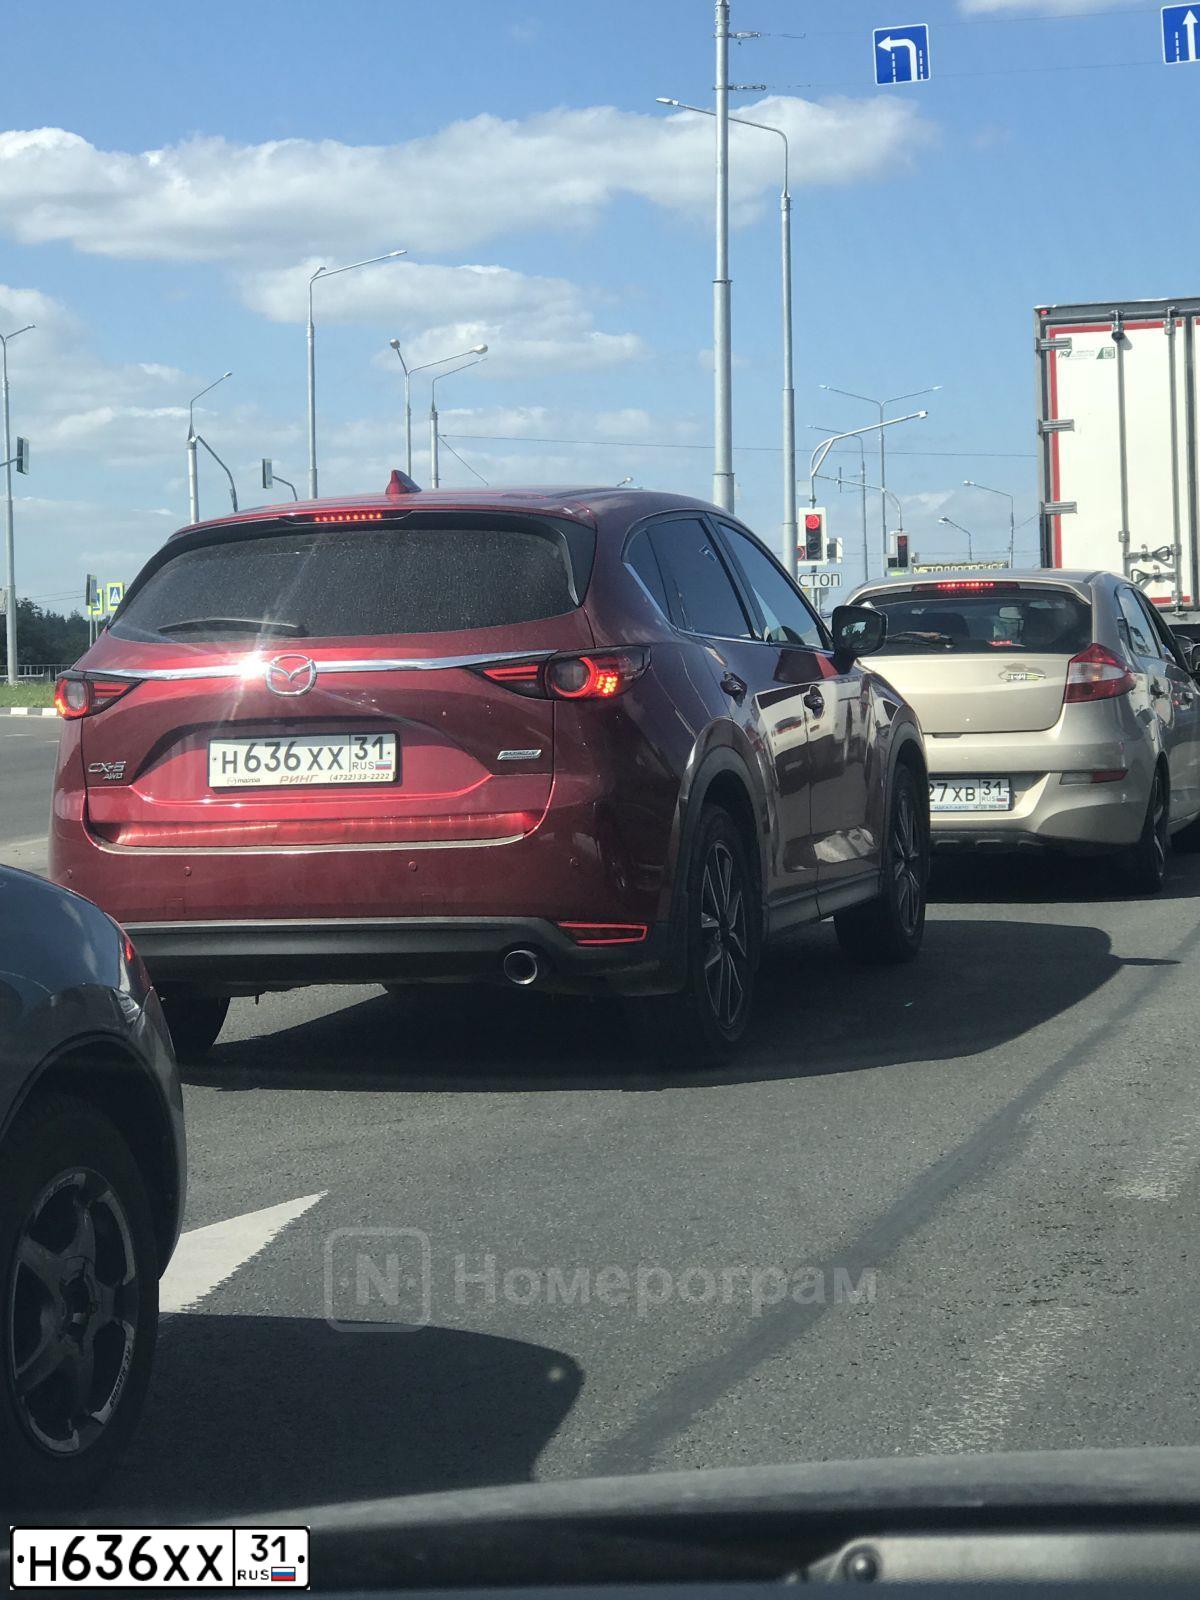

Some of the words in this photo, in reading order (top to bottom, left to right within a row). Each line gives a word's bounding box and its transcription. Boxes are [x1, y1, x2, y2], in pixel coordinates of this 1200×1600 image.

[799, 573, 840, 587] СТОП
[221, 741, 344, 774] Н636ХХ
[354, 736, 384, 760] 31
[88, 761, 127, 772] CX-5
[352, 761, 375, 770] RUS
[279, 774, 319, 784] РИНГ
[982, 781, 1002, 796] 31
